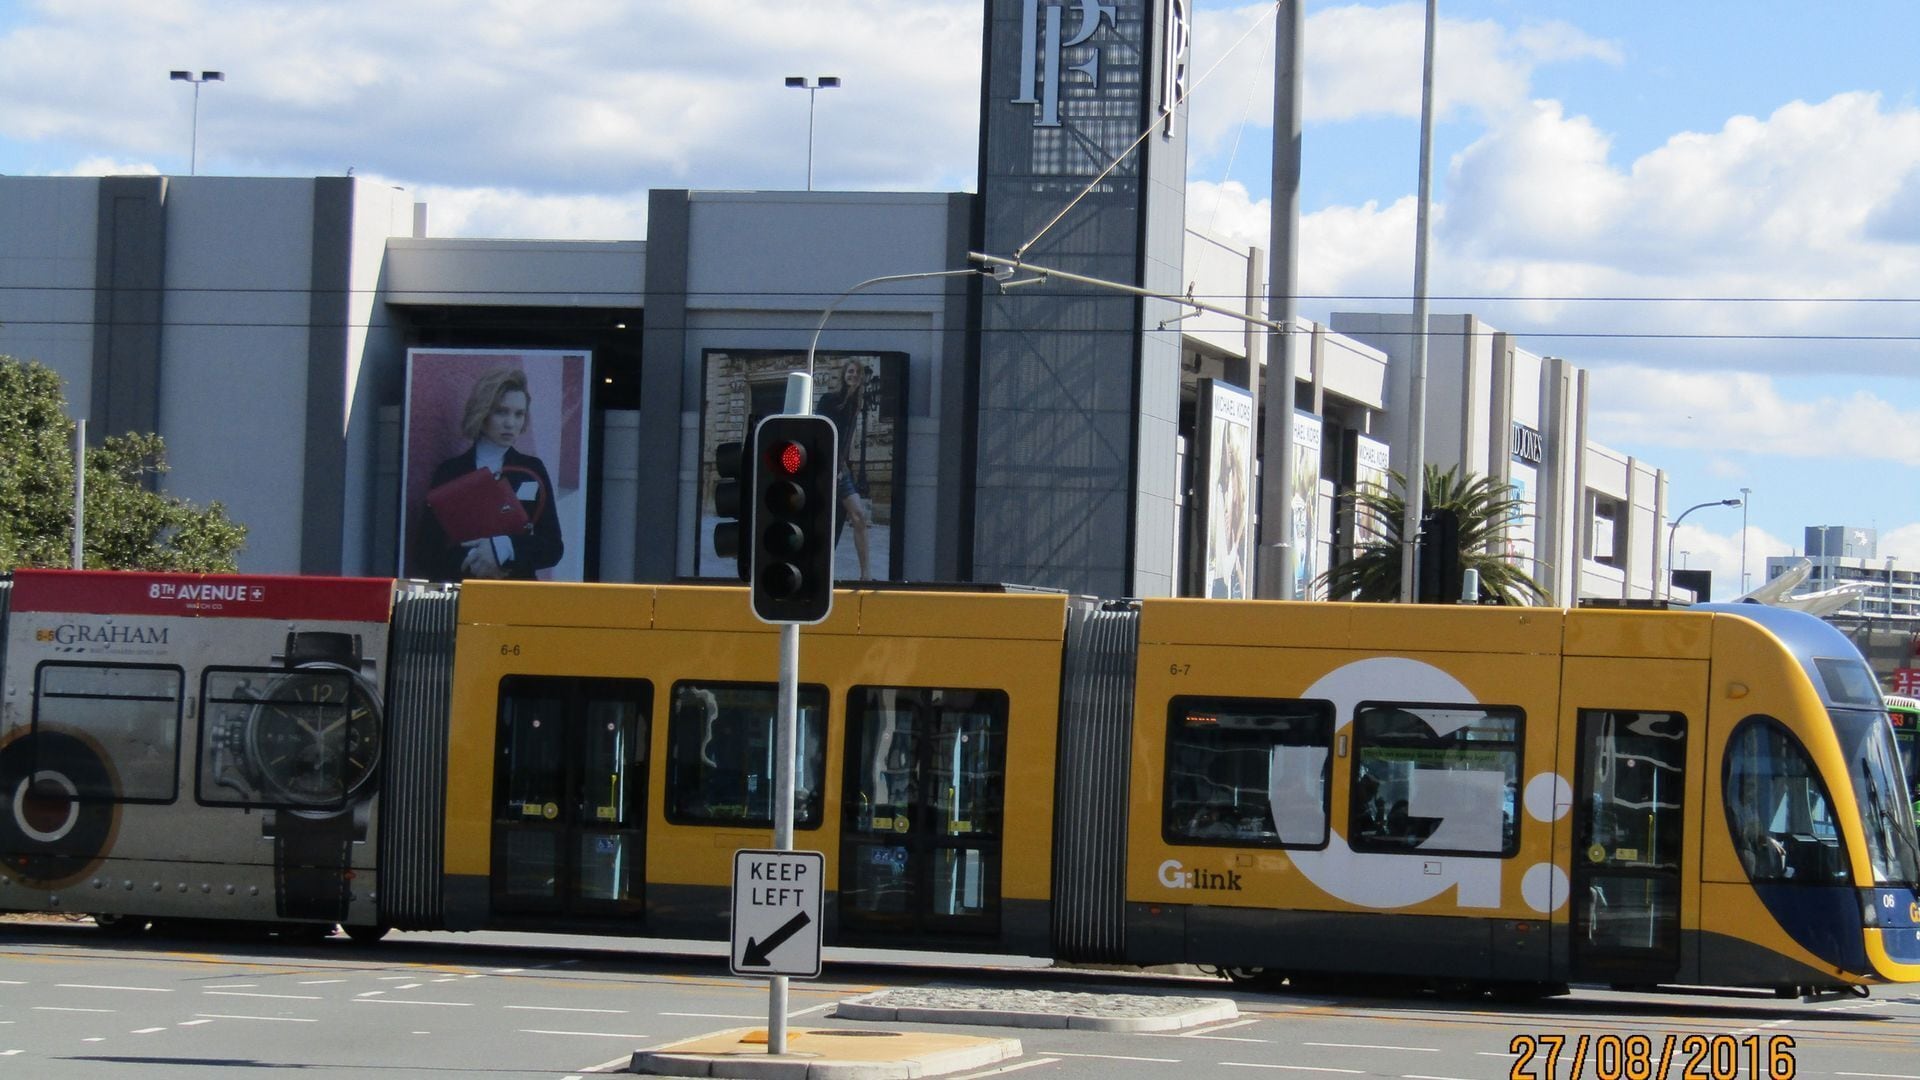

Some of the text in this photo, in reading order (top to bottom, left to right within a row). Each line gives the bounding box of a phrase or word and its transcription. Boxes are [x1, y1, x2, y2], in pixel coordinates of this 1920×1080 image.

[1215, 394, 1250, 422] MICHAEL KORS
[1307, 426, 1320, 445] KORS
[1520, 429, 1543, 464] JONES
[149, 583, 247, 601] 8TH AVENUE
[55, 624, 168, 645] GRAHAM
[500, 644, 521, 656] 6-6
[1169, 663, 1191, 676] 6-7
[751, 862, 807, 882] KEEP
[752, 887, 804, 907] LEFT
[1883, 894, 1895, 908] 06
